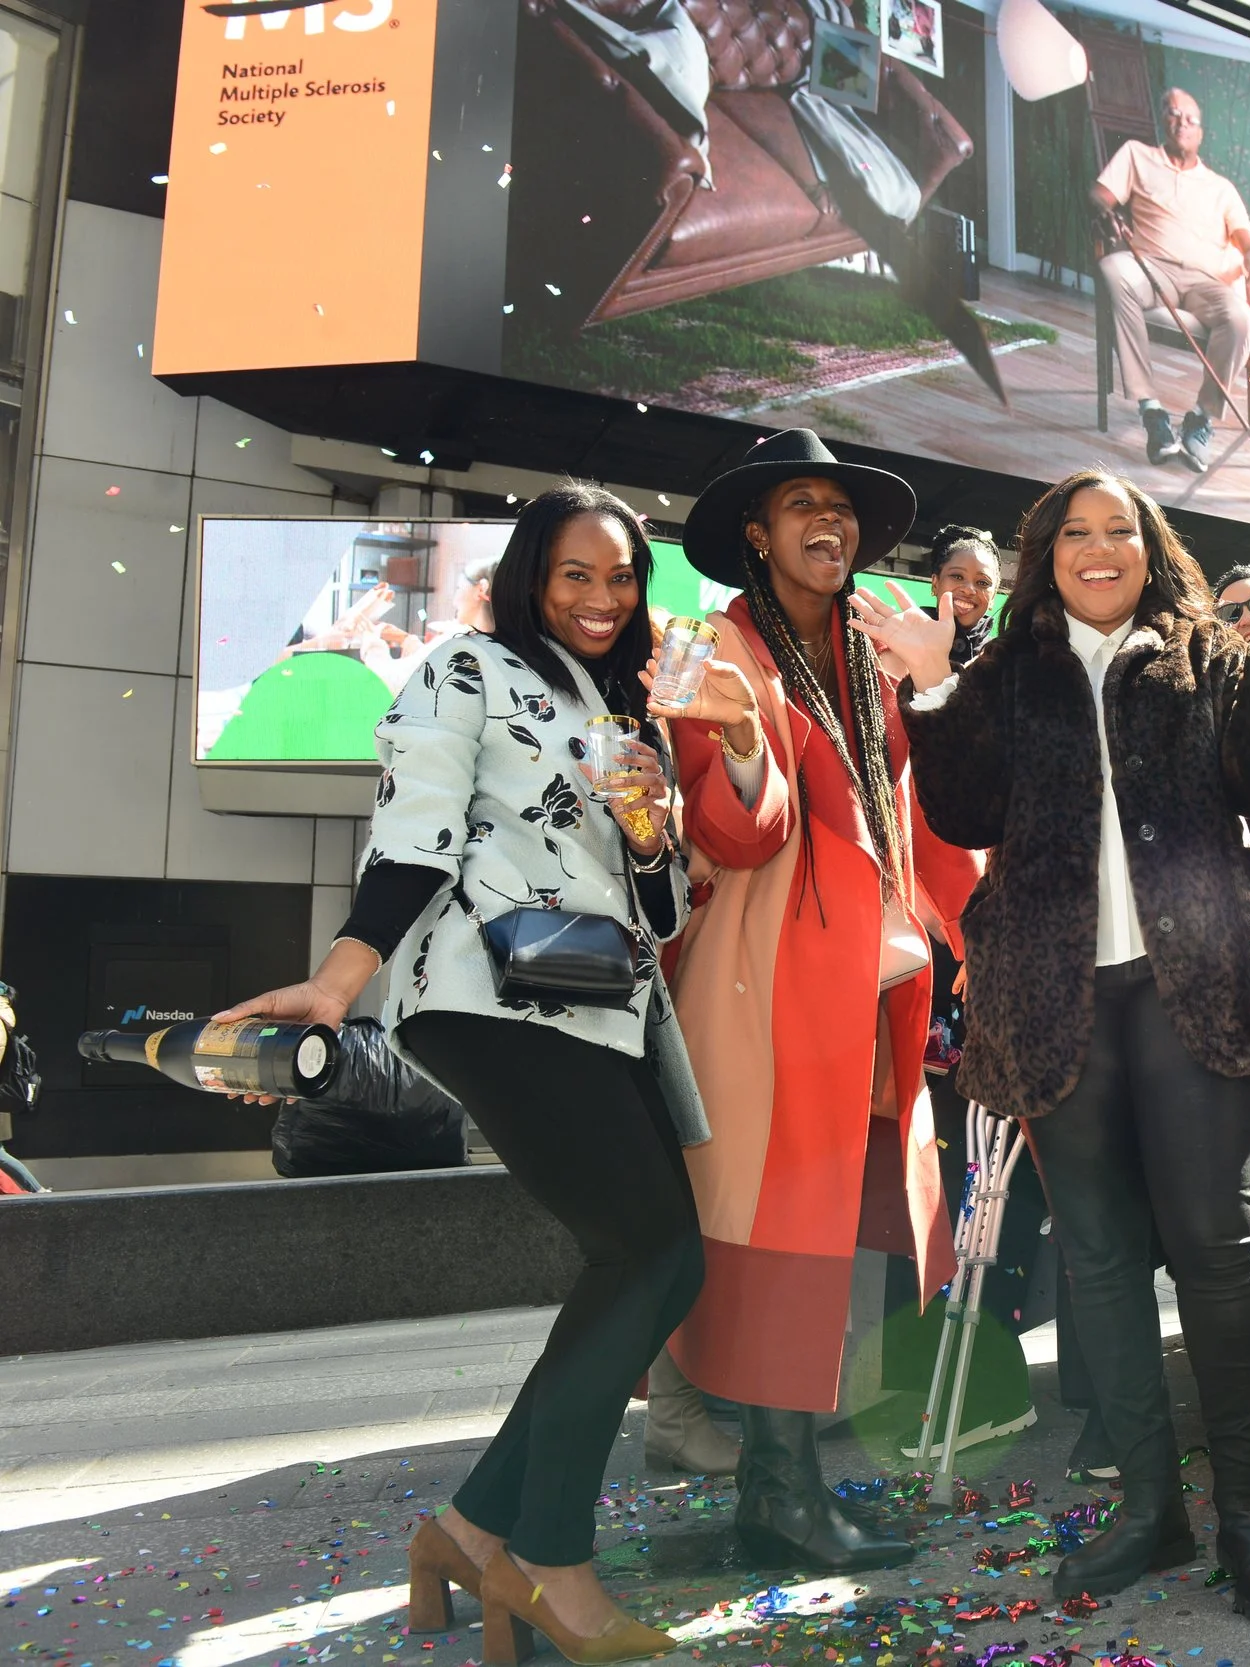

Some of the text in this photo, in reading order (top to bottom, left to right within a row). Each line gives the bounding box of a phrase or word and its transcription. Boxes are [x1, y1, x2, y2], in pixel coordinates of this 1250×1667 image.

[222, 58, 304, 79] National
[219, 77, 386, 104] Multiple Sclerosis
[217, 108, 286, 128] Society
